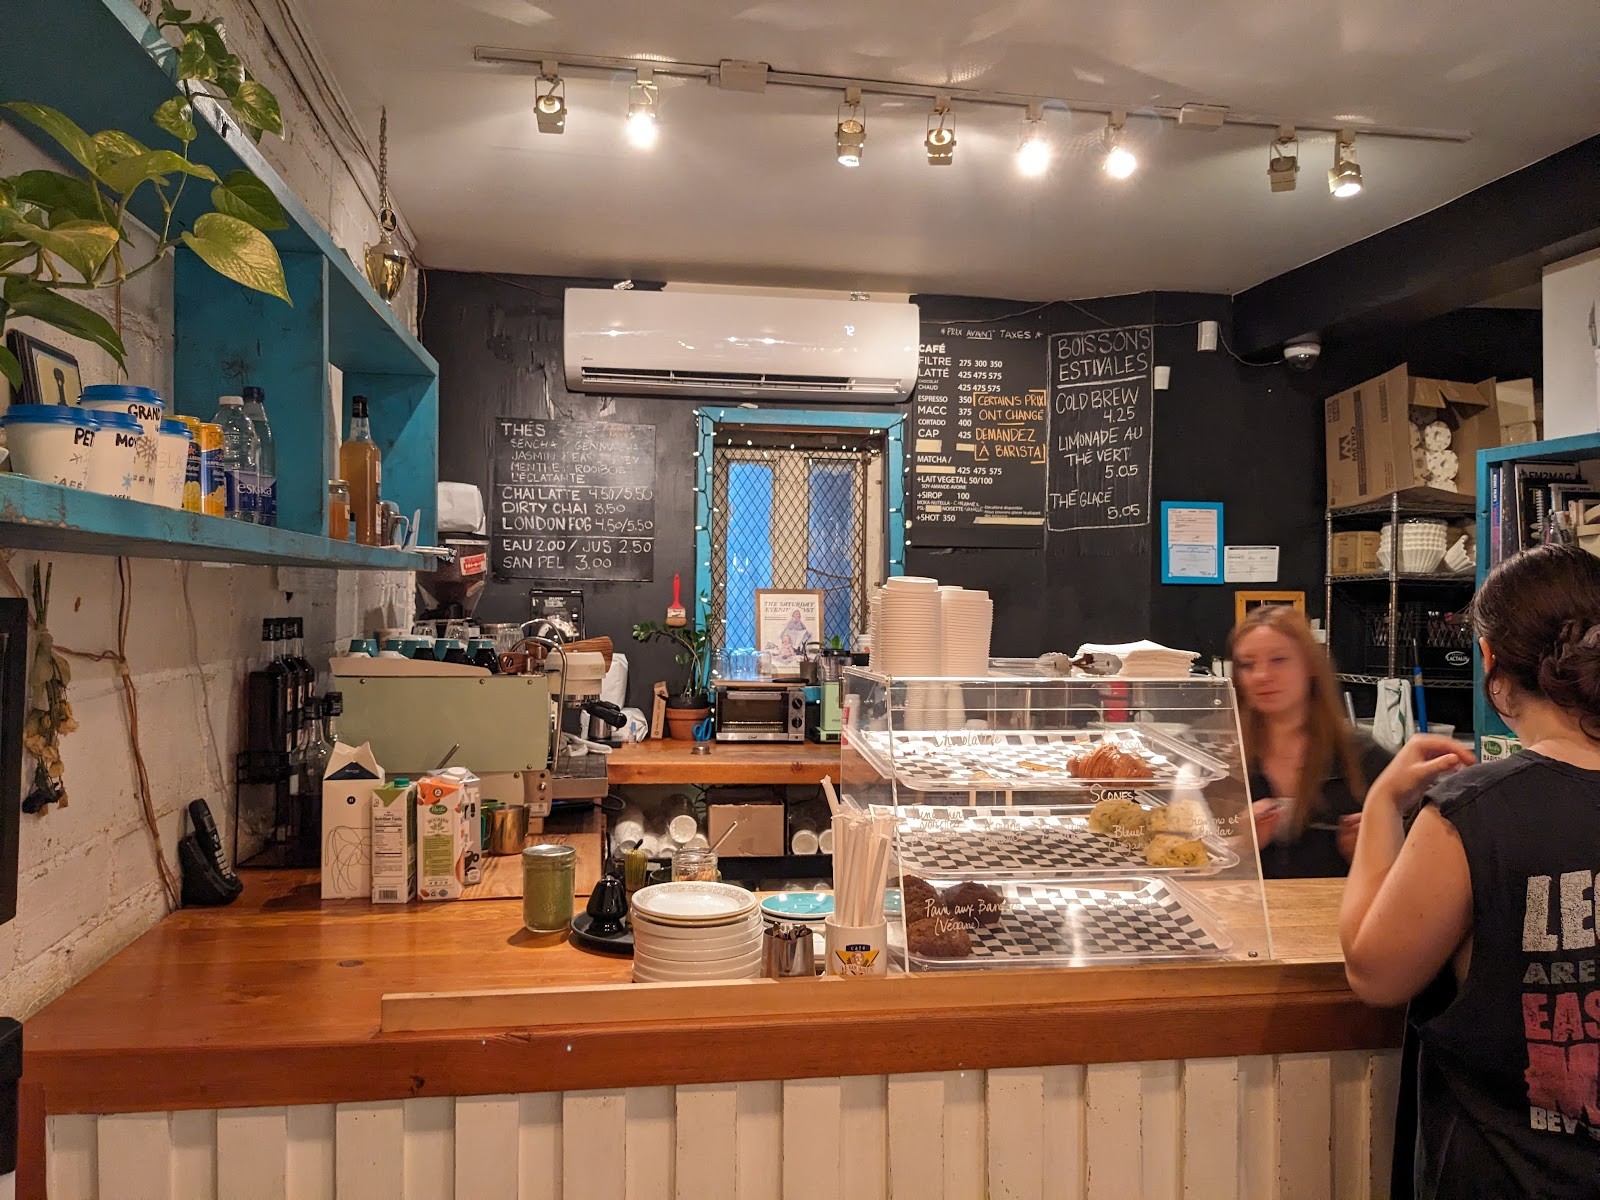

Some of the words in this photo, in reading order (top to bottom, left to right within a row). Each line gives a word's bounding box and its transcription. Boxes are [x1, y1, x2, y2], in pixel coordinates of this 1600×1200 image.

[947, 327, 962, 336] PRIX
[966, 329, 994, 339] AVANT
[1000, 329, 1031, 339] TAXES
[919, 343, 946, 354] CAFÉ
[1058, 329, 1150, 360] BOISSONS
[918, 356, 952, 366] FILTRE
[959, 359, 972, 367] 275
[989, 360, 1003, 368] 350
[1059, 353, 1148, 382] ESTIVALES
[918, 368, 949, 378] LATTÉ
[958, 371, 972, 379] 425
[972, 372, 987, 380] 475
[988, 372, 1002, 380] 575
[917, 395, 948, 403] ESPRESSO
[958, 396, 972, 404] 350
[977, 395, 1022, 406] CERTAINS
[1055, 391, 1089, 415] COLD
[1091, 387, 1140, 409] BREW
[917, 405, 947, 415] MACC
[958, 408, 972, 416] 375
[978, 409, 1002, 421] ONT
[1103, 405, 1135, 423] 4.25
[501, 421, 546, 437] THÉS
[917, 418, 946, 426] CORTADO
[958, 419, 972, 427] 400
[918, 428, 940, 438] CAP
[958, 431, 972, 439] 425
[975, 427, 1036, 442] DEMANDEZ
[1058, 426, 1119, 451] LIMONADE
[1124, 426, 1143, 440] AU
[995, 444, 1042, 459] BARISTA
[1096, 447, 1130, 463] VERT
[917, 455, 947, 463] MATCHA
[957, 467, 970, 475] 425
[973, 467, 986, 475] 475
[1104, 464, 1138, 479] 5.05
[969, 477, 993, 485] 50/100
[502, 487, 535, 500] CHAI
[538, 488, 580, 501] LATTE
[957, 492, 970, 500] 100
[502, 501, 547, 514] DIRTY
[552, 502, 587, 515] CHAI
[1107, 503, 1140, 520] 5.05
[502, 516, 566, 531] LONDON
[568, 516, 592, 531] FOG
[916, 514, 940, 522] +SHOT
[503, 538, 533, 552] EAU
[582, 540, 612, 554] JUS
[618, 539, 652, 553] 2.50
[503, 556, 533, 569] SAN
[538, 555, 565, 569] PEL
[575, 554, 612, 570] 3.00
[1522, 960, 1596, 985] ARE
